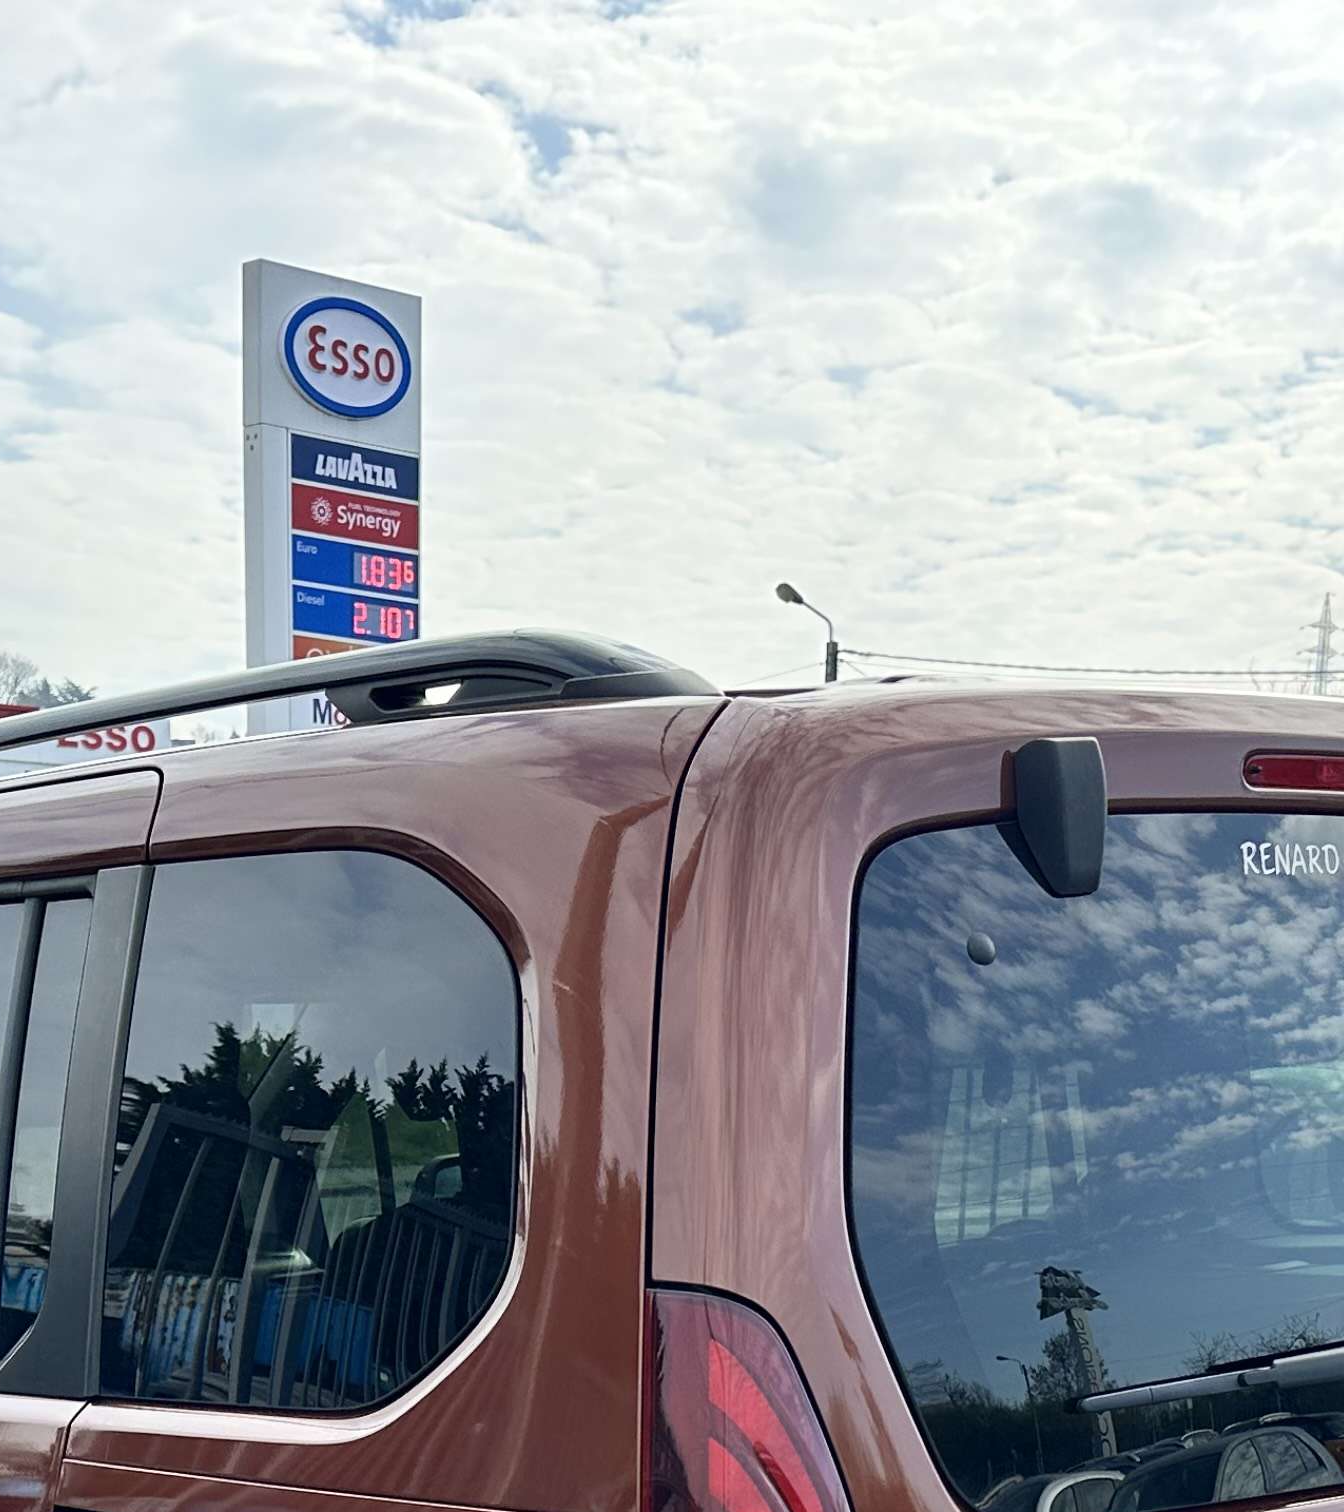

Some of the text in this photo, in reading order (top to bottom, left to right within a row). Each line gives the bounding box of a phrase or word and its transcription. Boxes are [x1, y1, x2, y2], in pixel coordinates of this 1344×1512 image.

[307, 325, 396, 383] ESSO
[315, 452, 398, 489] LAVAZZA
[336, 505, 402, 538] Synergy
[296, 541, 318, 555] Euro
[296, 591, 325, 606] Diesel
